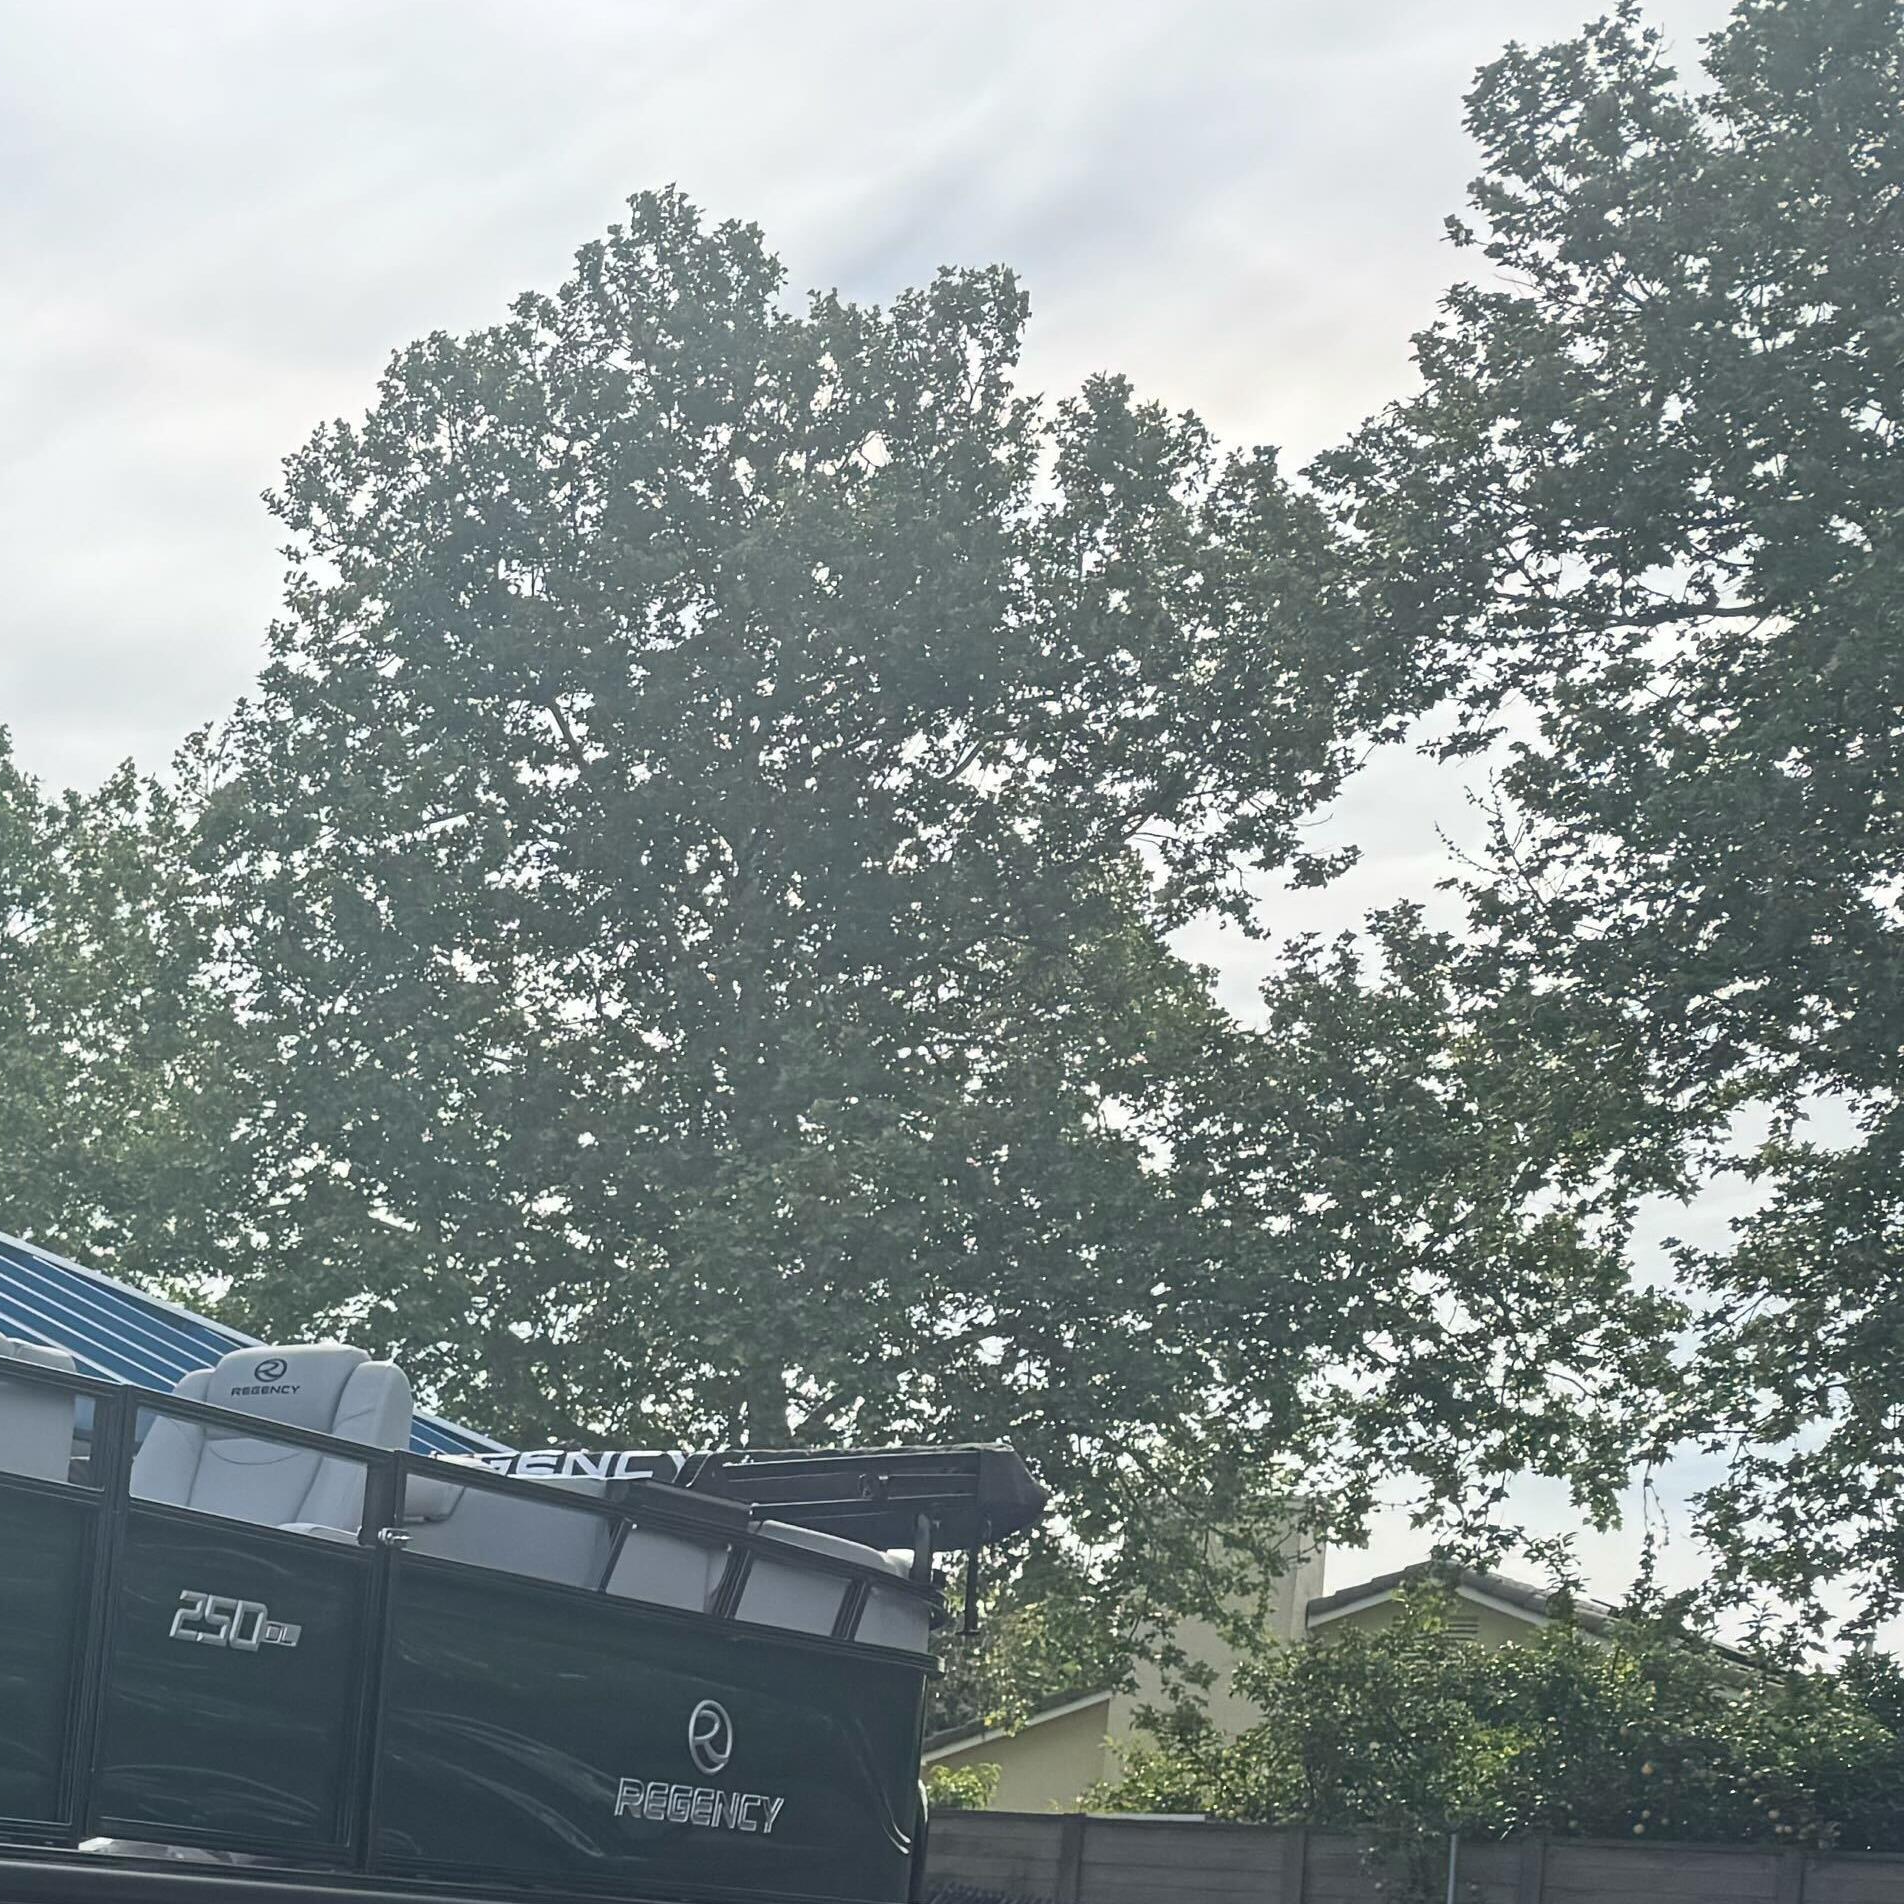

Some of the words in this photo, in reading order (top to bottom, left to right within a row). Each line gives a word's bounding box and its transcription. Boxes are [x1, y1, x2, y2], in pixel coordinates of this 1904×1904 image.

[231, 1385, 301, 1396] REGENCY
[169, 1590, 268, 1651] 250
[614, 1777, 784, 1833] REGENCY
